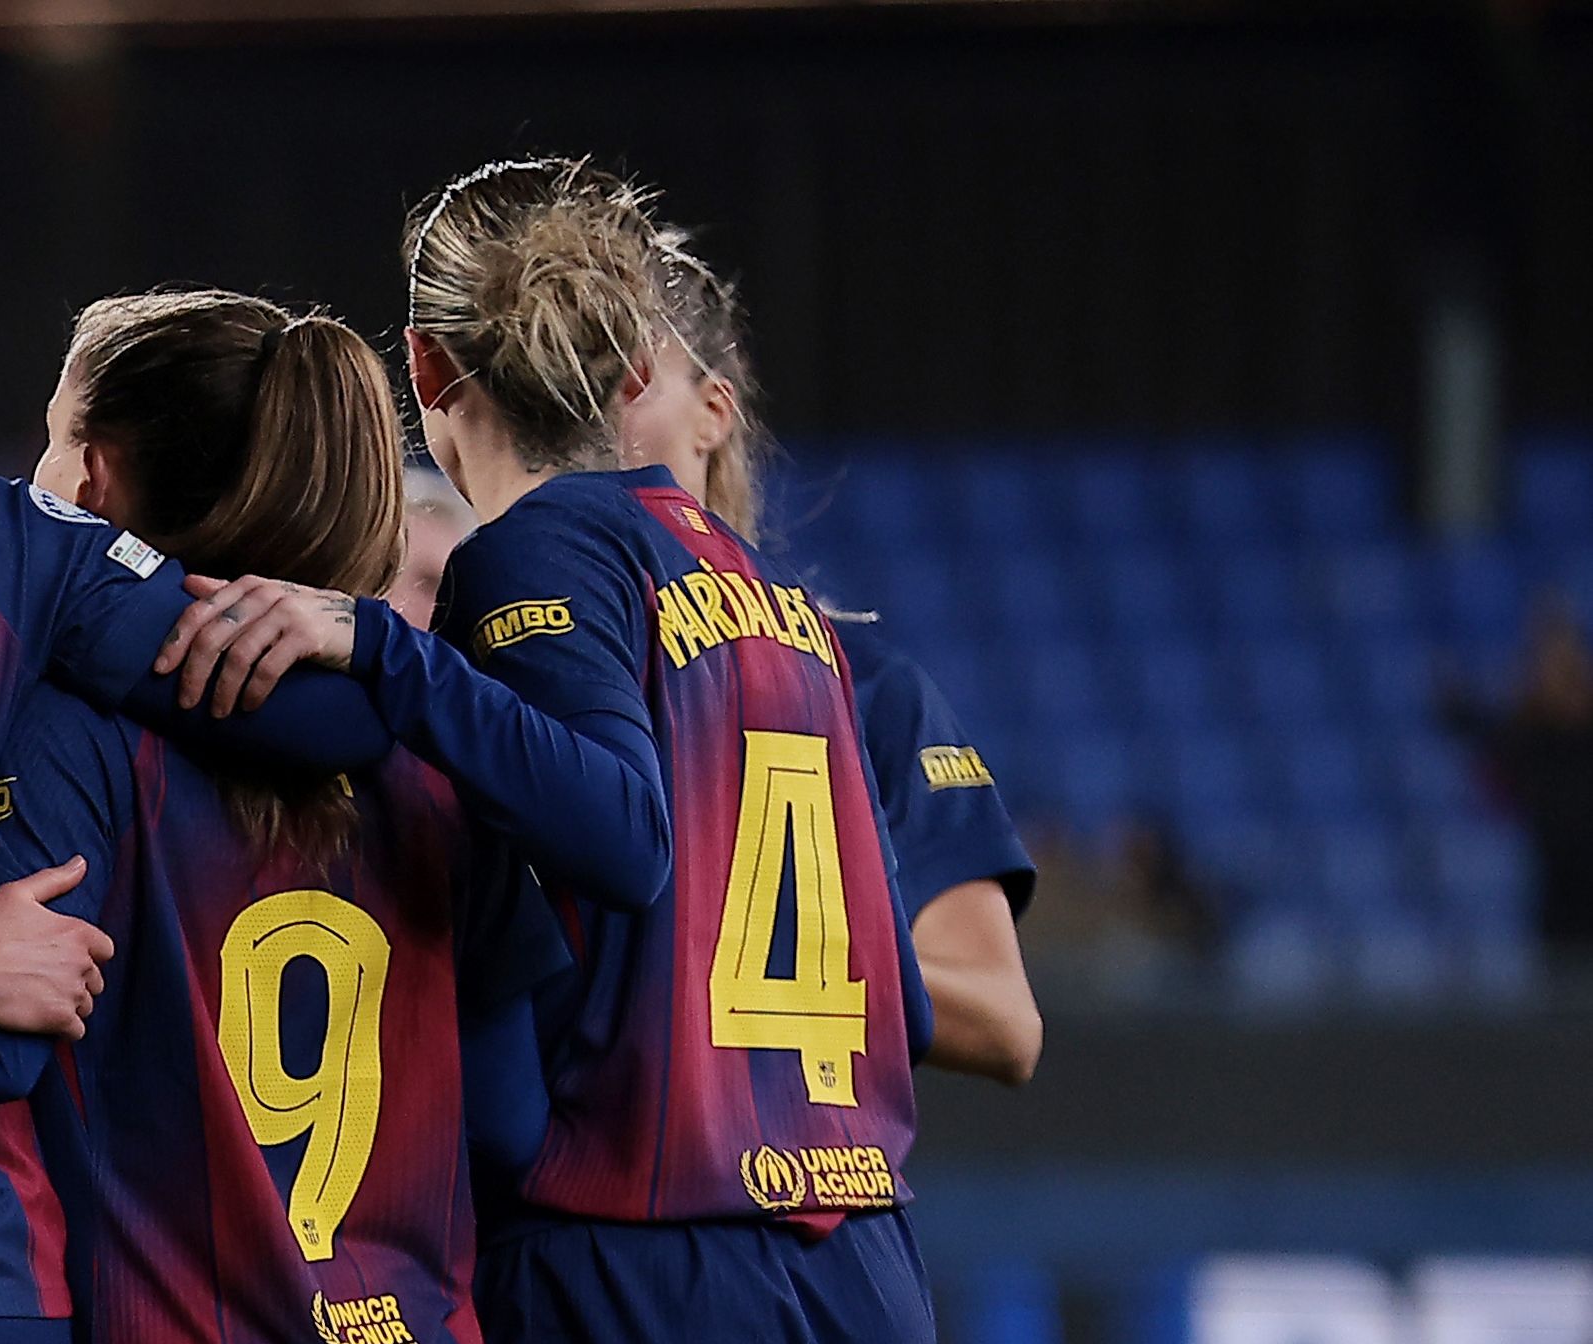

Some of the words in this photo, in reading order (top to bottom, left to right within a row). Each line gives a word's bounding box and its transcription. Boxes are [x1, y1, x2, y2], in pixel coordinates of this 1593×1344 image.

[483, 604, 571, 646] IMBO
[709, 730, 868, 1109] 4
[216, 888, 392, 1262] 9
[798, 1146, 889, 1173] UNHCR
[813, 1171, 895, 1197] ACNUR
